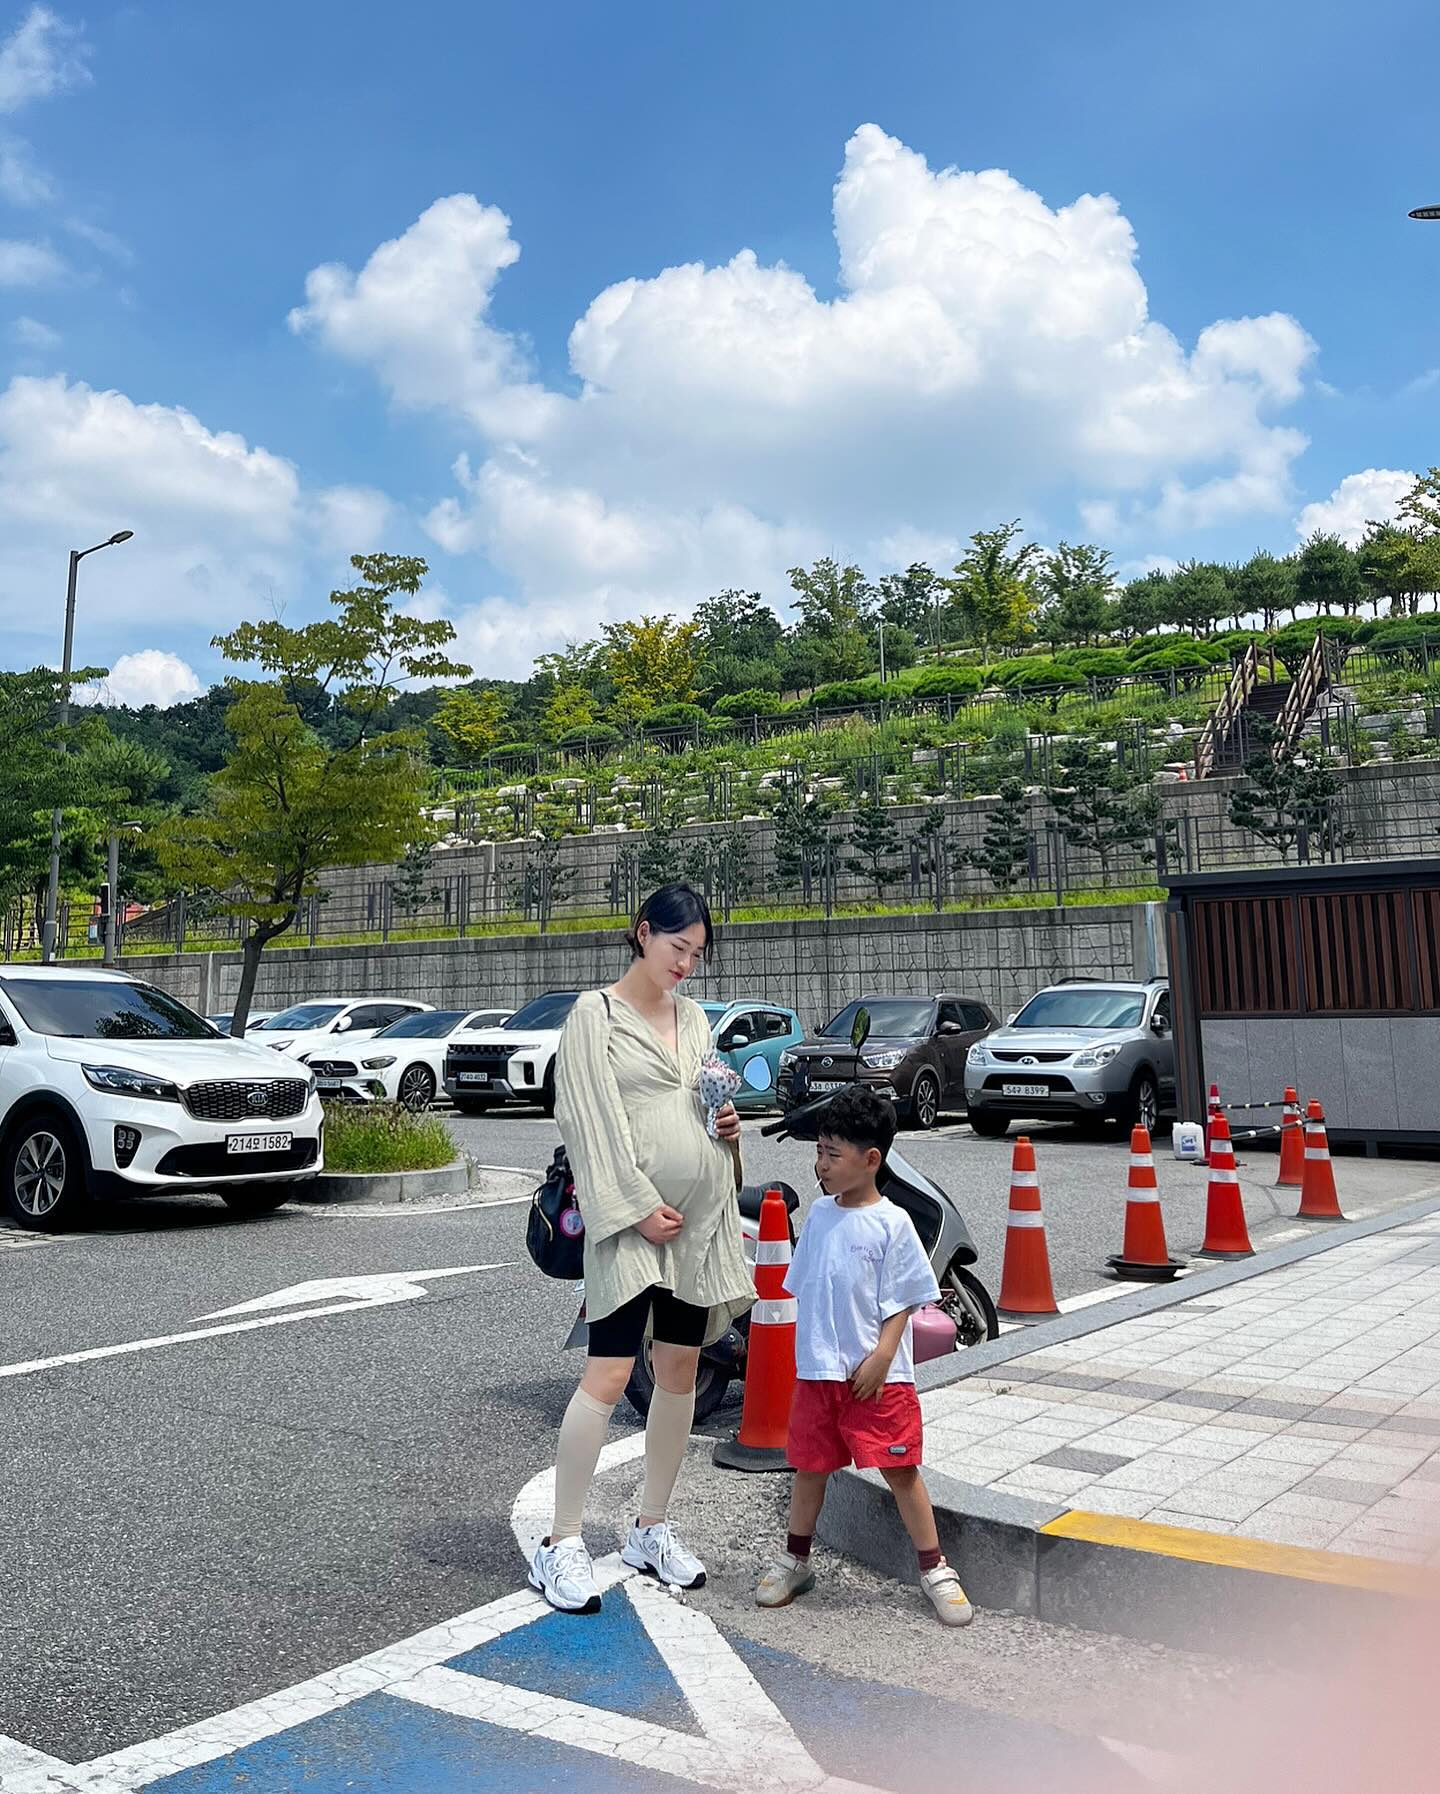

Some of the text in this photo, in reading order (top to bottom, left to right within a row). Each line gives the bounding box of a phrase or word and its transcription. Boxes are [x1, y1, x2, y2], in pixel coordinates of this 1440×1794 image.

[1024, 1086, 1045, 1095] 8399
[250, 1093, 267, 1104] KIA
[263, 1135, 288, 1149] 1582
